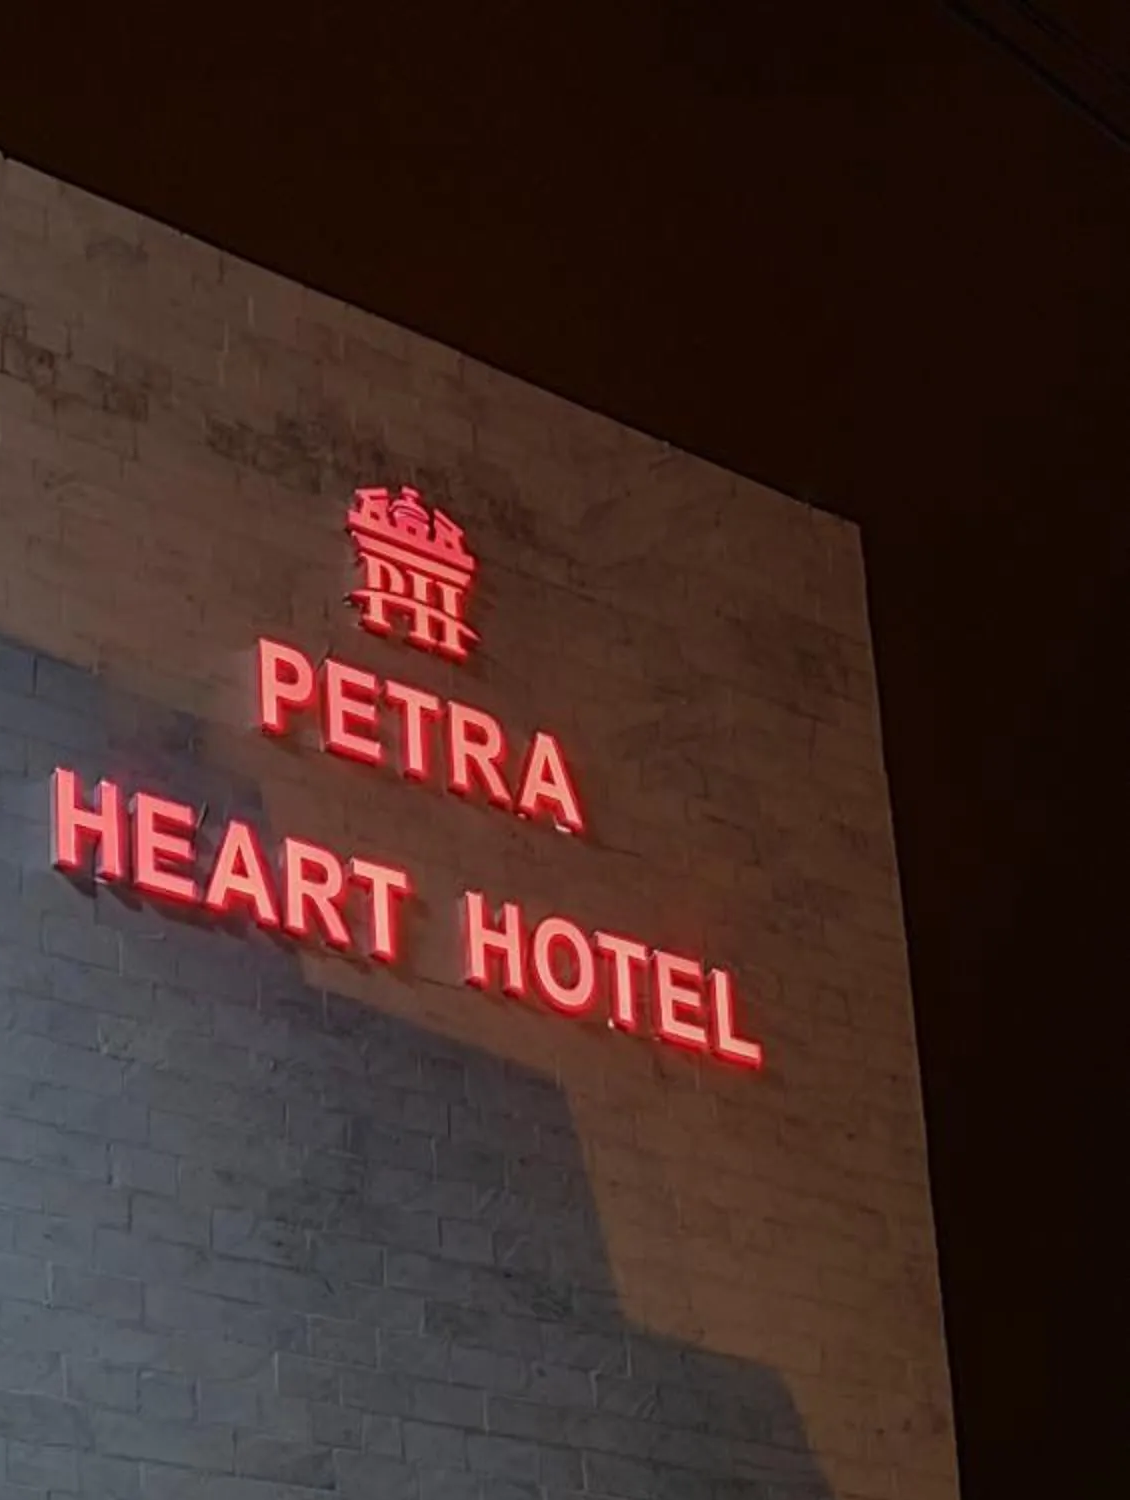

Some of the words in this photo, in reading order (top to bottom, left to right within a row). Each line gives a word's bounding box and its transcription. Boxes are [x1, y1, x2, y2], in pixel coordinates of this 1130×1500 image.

[257, 637, 584, 834] PETRA
[51, 767, 410, 963] HEART
[465, 890, 763, 1068] HOTEL
